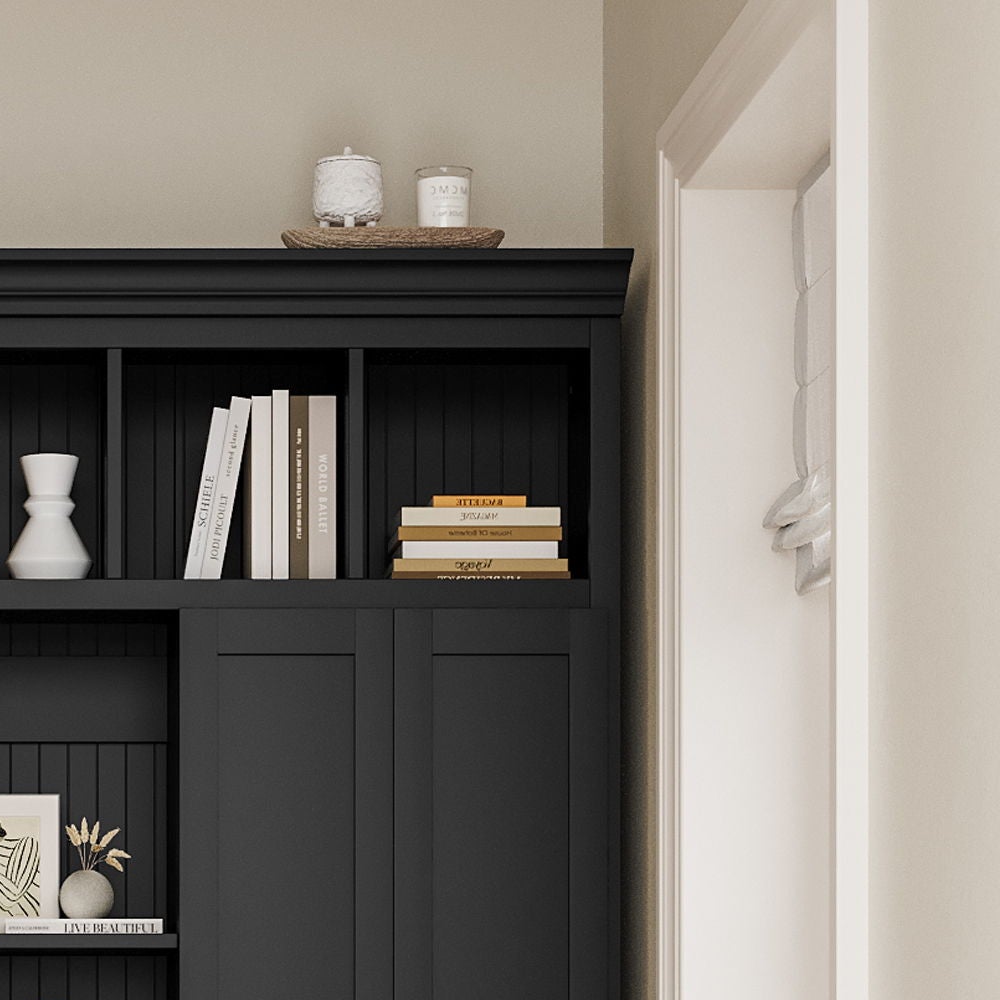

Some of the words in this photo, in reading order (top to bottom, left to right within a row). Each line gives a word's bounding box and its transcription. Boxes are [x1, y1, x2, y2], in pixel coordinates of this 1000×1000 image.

[224, 450, 234, 477] second
[230, 424, 240, 450] glance
[318, 454, 328, 492] WORLD
[197, 474, 215, 528] SCHIELE
[214, 493, 229, 536] PICOULT
[318, 497, 328, 534] BALLET
[210, 538, 221, 561] JODI
[64, 923, 90, 933] LIVE
[93, 923, 158, 933] BEAUTIFUL
